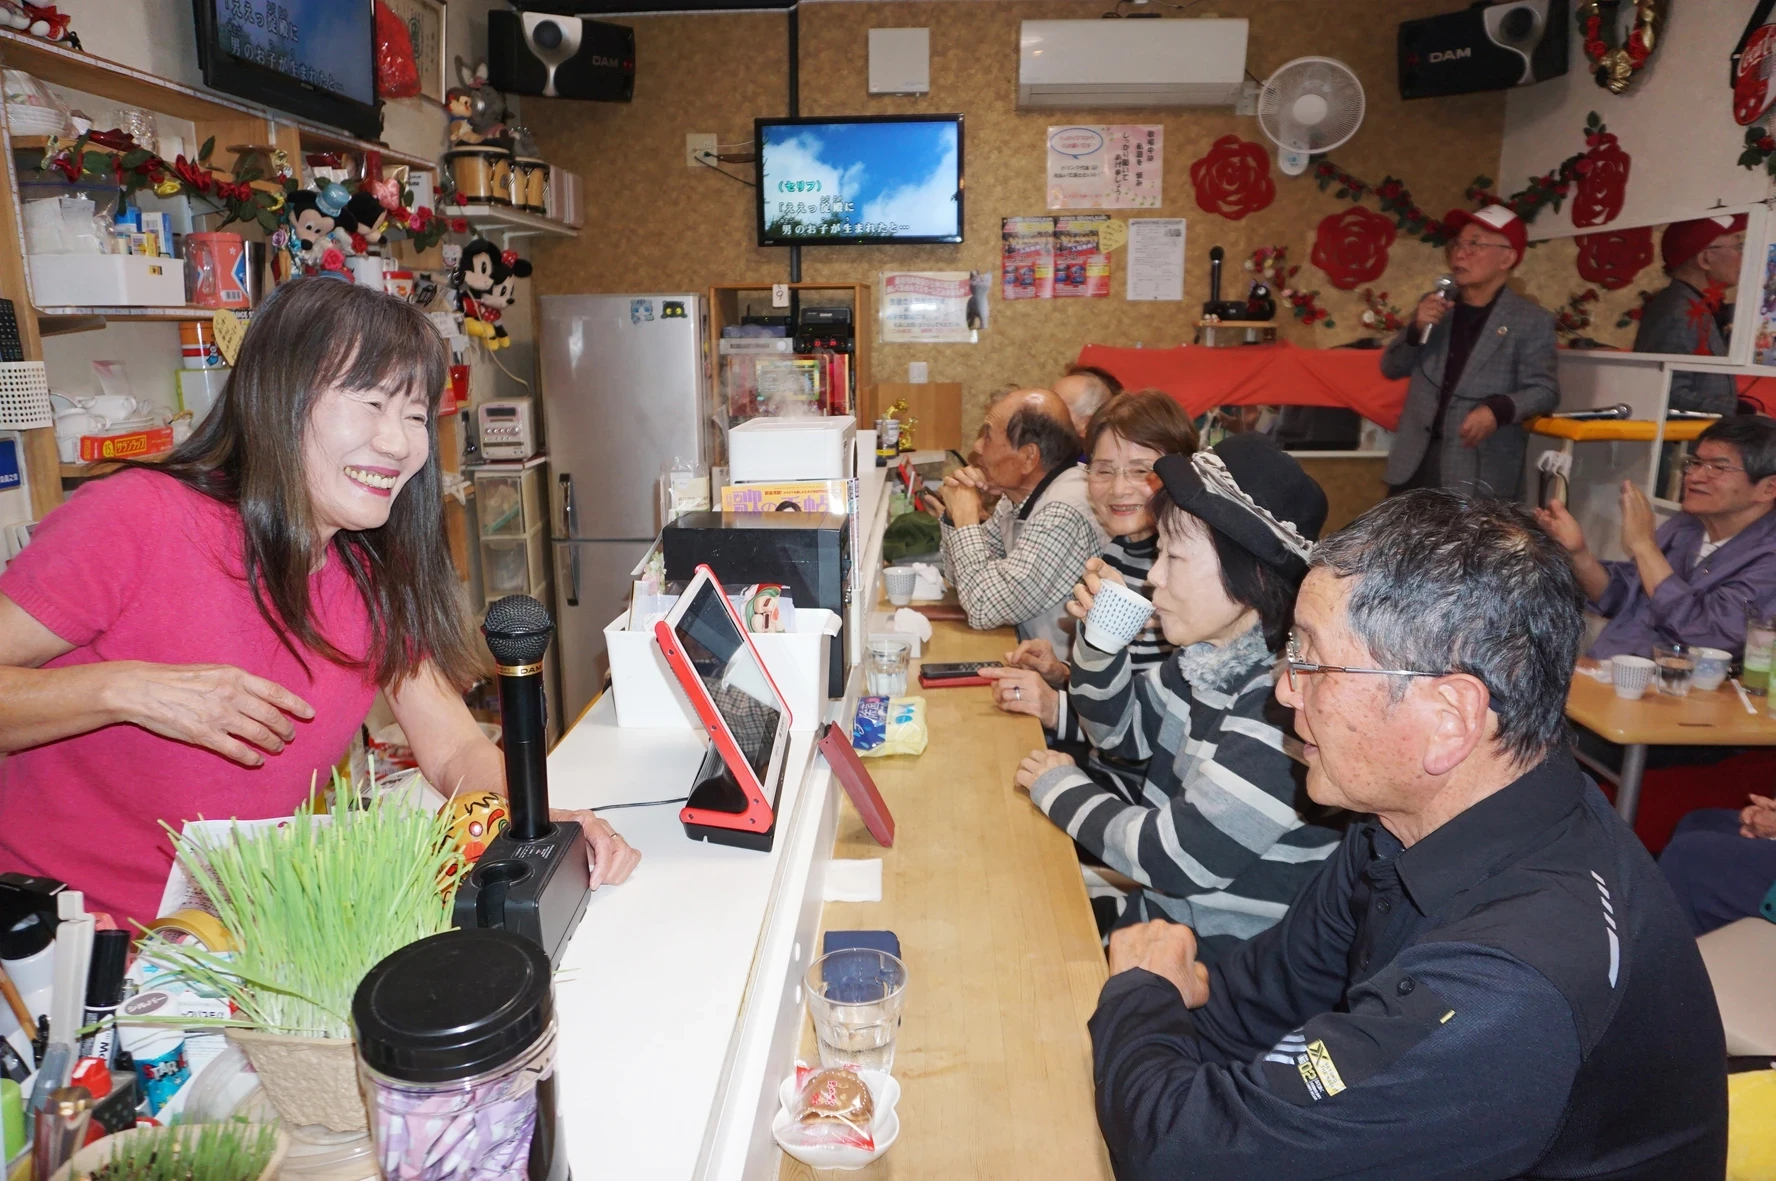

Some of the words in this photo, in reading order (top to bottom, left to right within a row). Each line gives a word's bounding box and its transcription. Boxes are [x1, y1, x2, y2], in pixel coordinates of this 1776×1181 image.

[592, 55, 619, 68] DAM
[1429, 47, 1471, 63] DAM
[776, 290, 784, 300] 9
